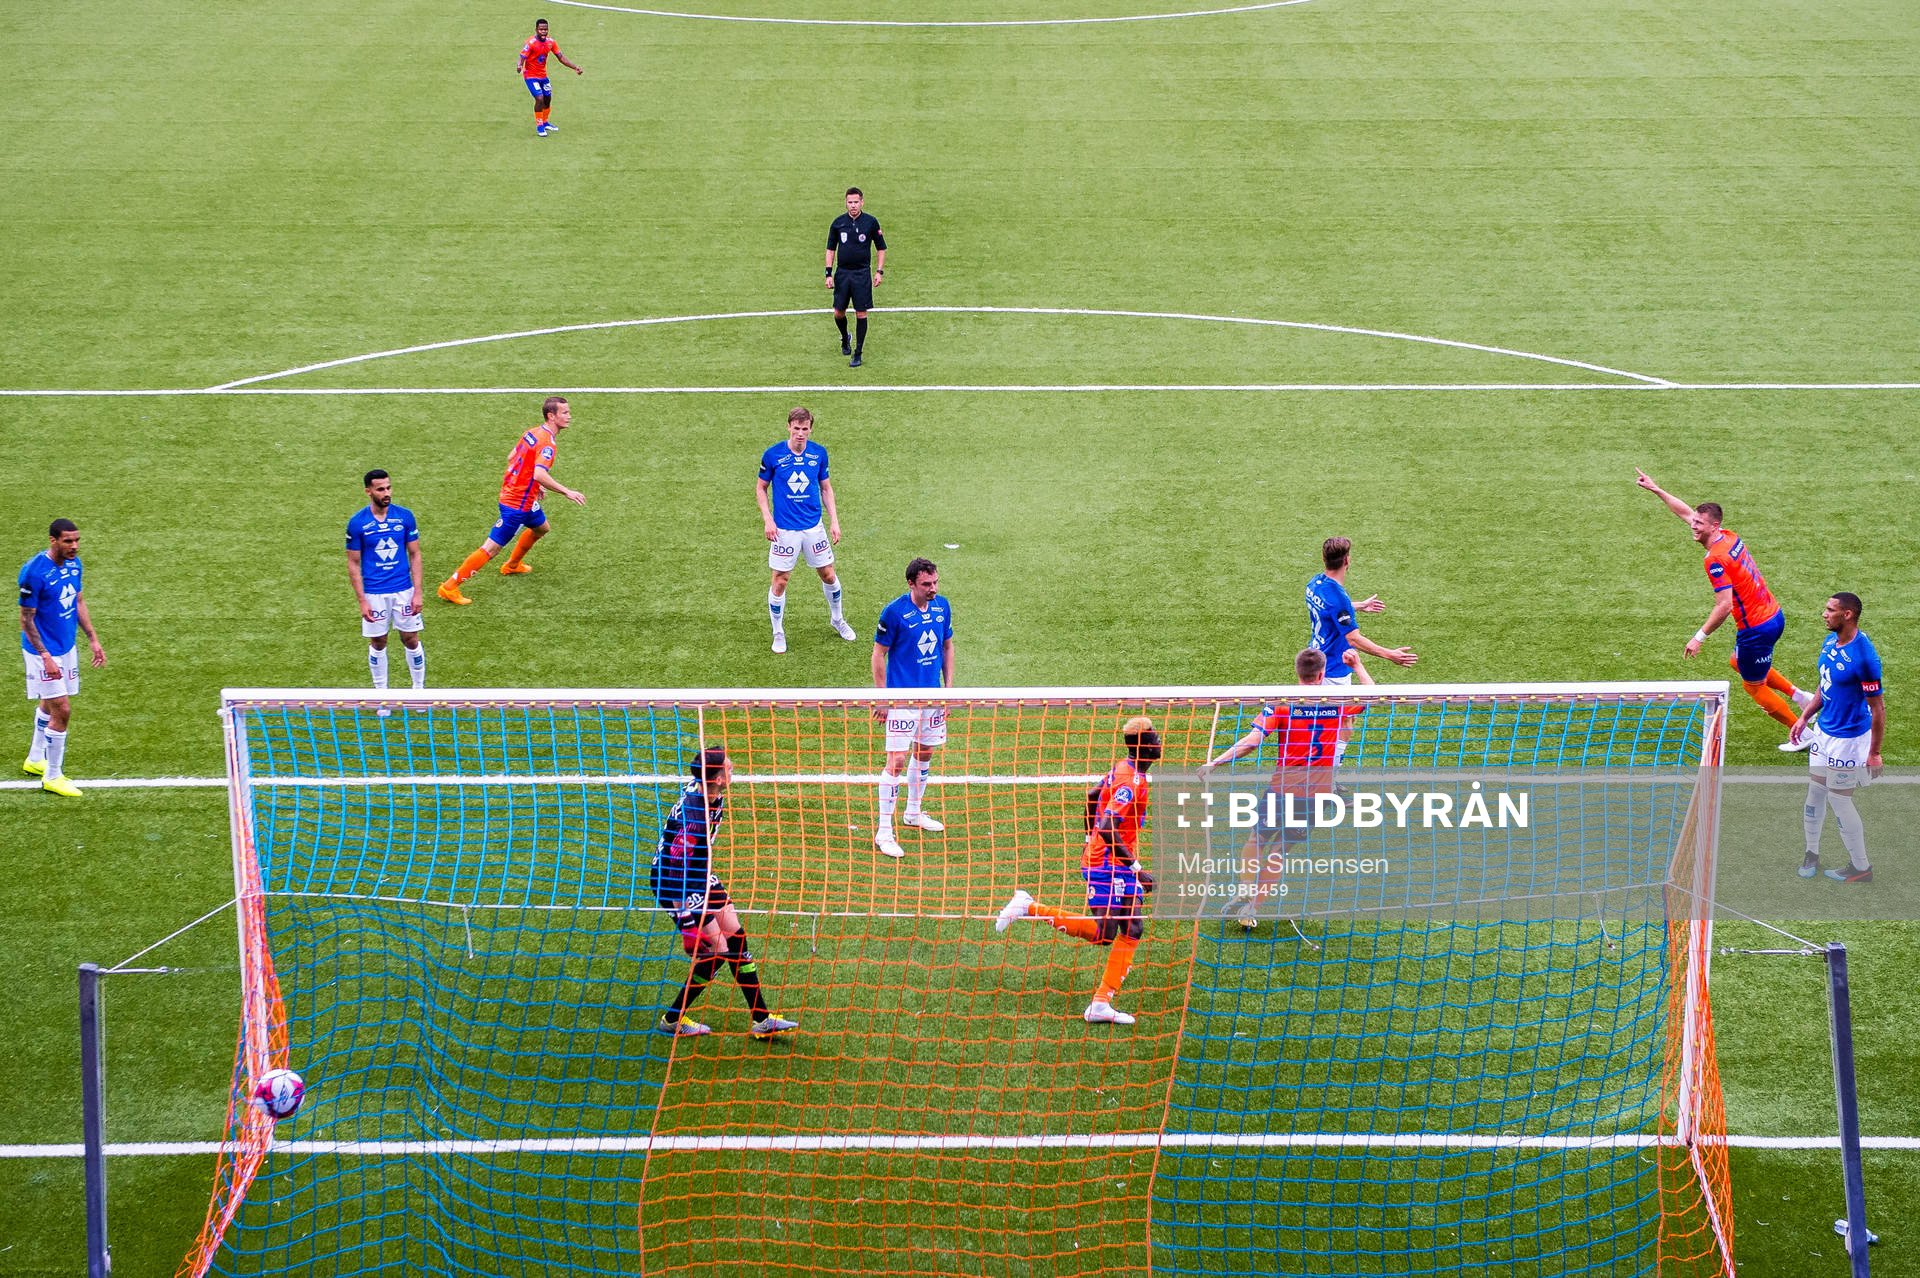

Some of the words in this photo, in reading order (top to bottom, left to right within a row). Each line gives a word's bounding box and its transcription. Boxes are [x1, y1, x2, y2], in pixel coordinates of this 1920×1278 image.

[773, 544, 795, 554] BDO
[892, 720, 915, 730] BDO
[1306, 724, 1324, 762] 3
[1828, 757, 1856, 769] BDO
